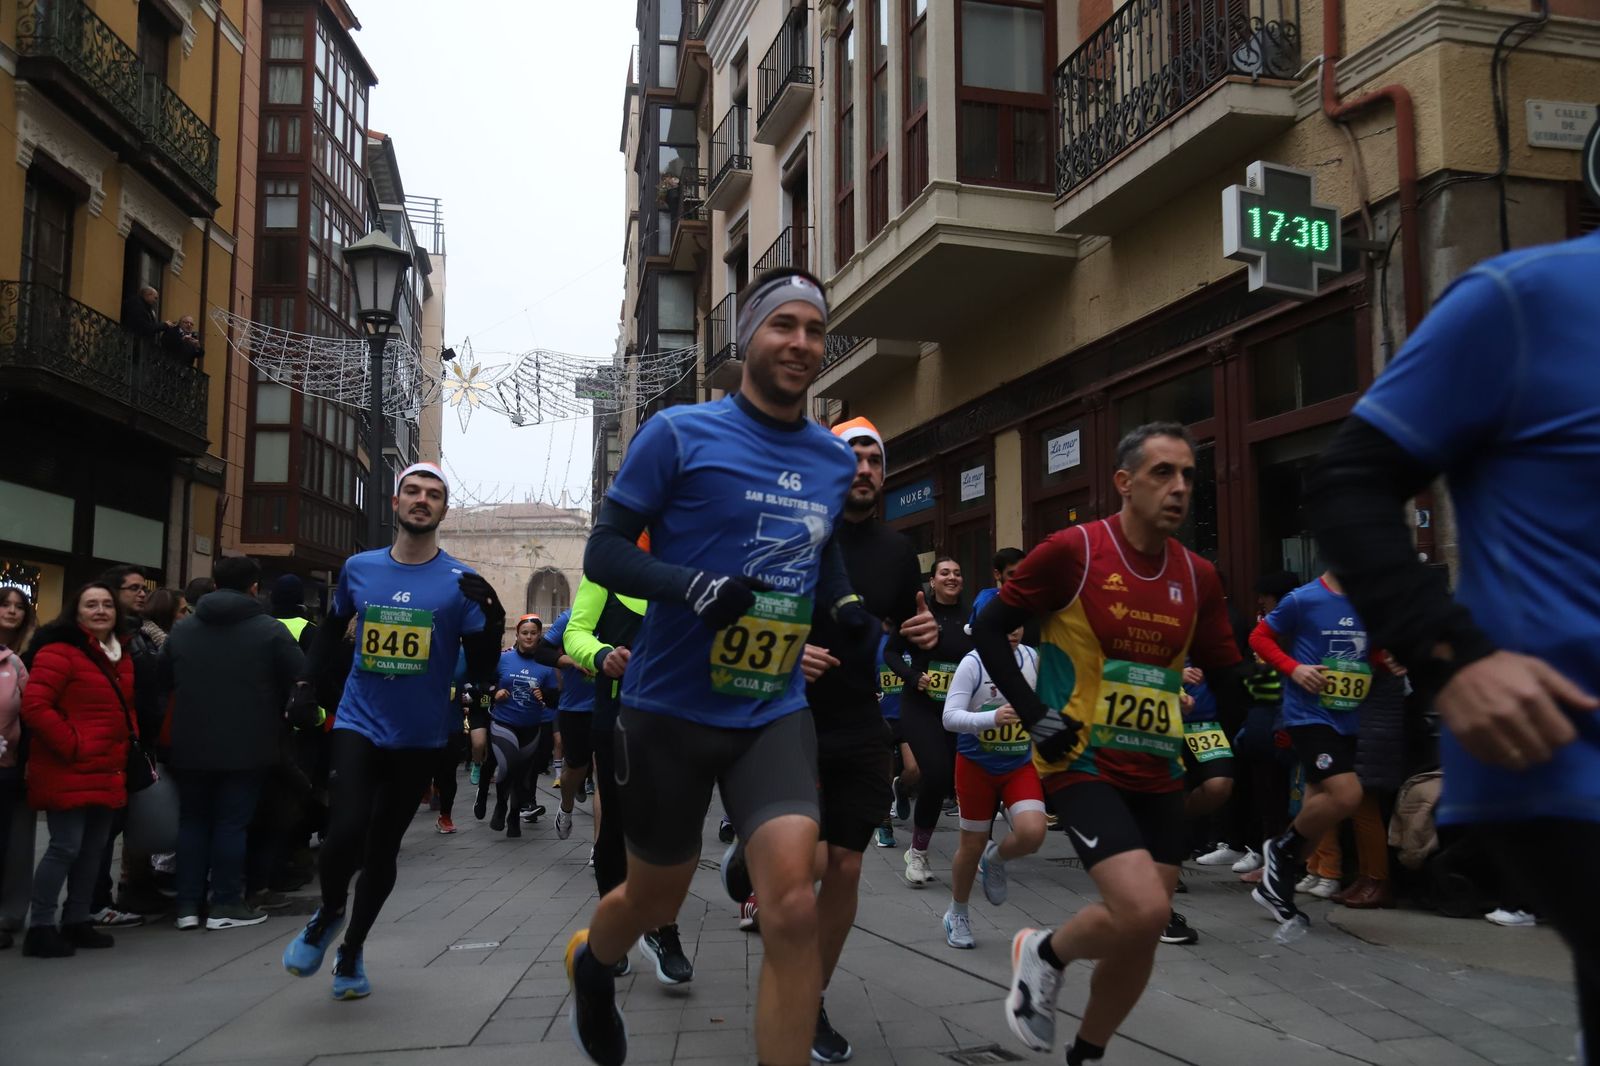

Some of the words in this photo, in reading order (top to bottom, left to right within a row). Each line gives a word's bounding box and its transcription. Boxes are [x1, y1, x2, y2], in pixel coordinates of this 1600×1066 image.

[1247, 207, 1329, 251] 17:30
[1050, 440, 1061, 454] La
[1061, 437, 1078, 450] mer
[777, 470, 803, 491] 46
[745, 490, 764, 502] SAN
[765, 493, 809, 510] SILVESTRE
[900, 490, 922, 506] NUXE
[391, 591, 412, 603] 46
[1338, 617, 1354, 627] 46
[366, 629, 419, 658] 846
[1128, 626, 1162, 642] VINO
[719, 625, 799, 673] 937
[1113, 638, 1131, 650] DE
[1134, 641, 1170, 657] TORO
[377, 661, 396, 669] CAJA
[397, 662, 423, 671] RURAL
[883, 674, 904, 687] 87
[1324, 675, 1365, 698] 638
[1104, 691, 1171, 734] 1269
[1188, 733, 1223, 752] 932
